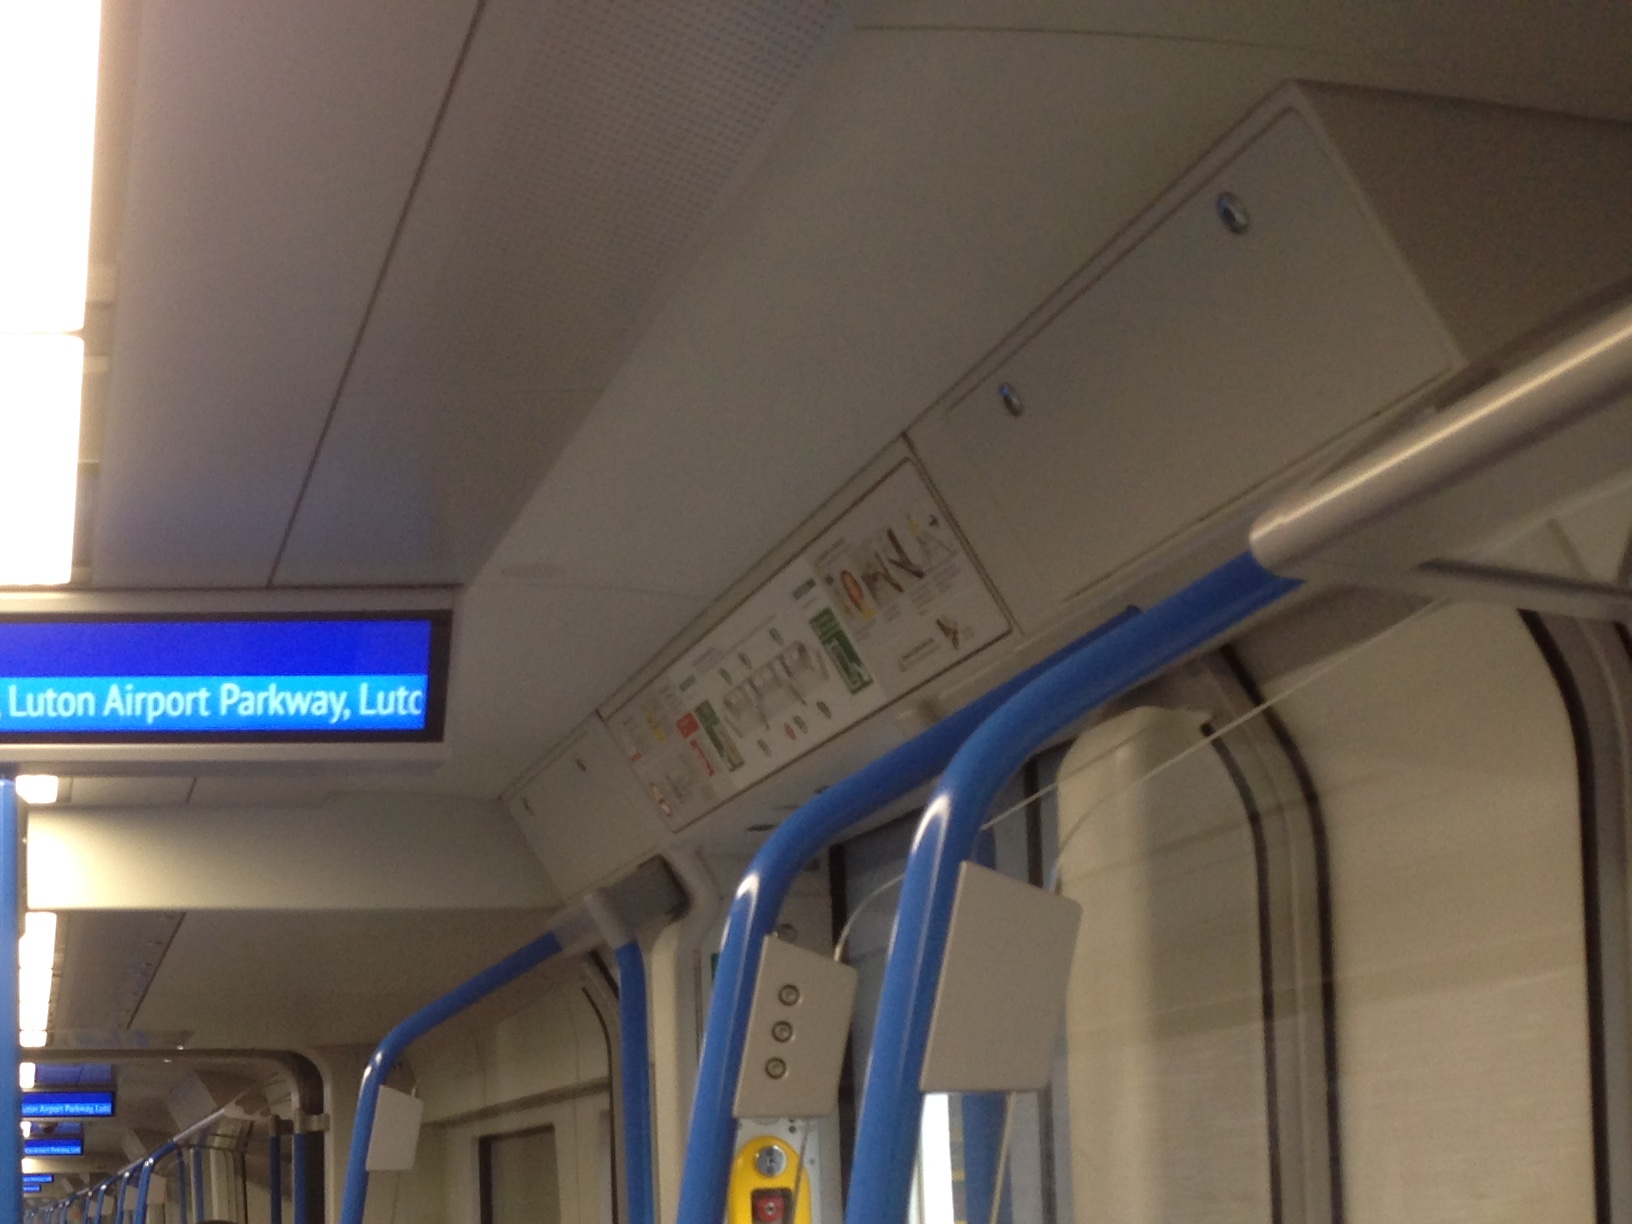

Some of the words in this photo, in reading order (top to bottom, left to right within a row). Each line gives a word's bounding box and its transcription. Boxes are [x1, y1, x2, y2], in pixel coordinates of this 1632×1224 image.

[8, 684, 96, 718] Luton
[103, 683, 211, 724] Airport
[219, 682, 351, 723] Parkway,
